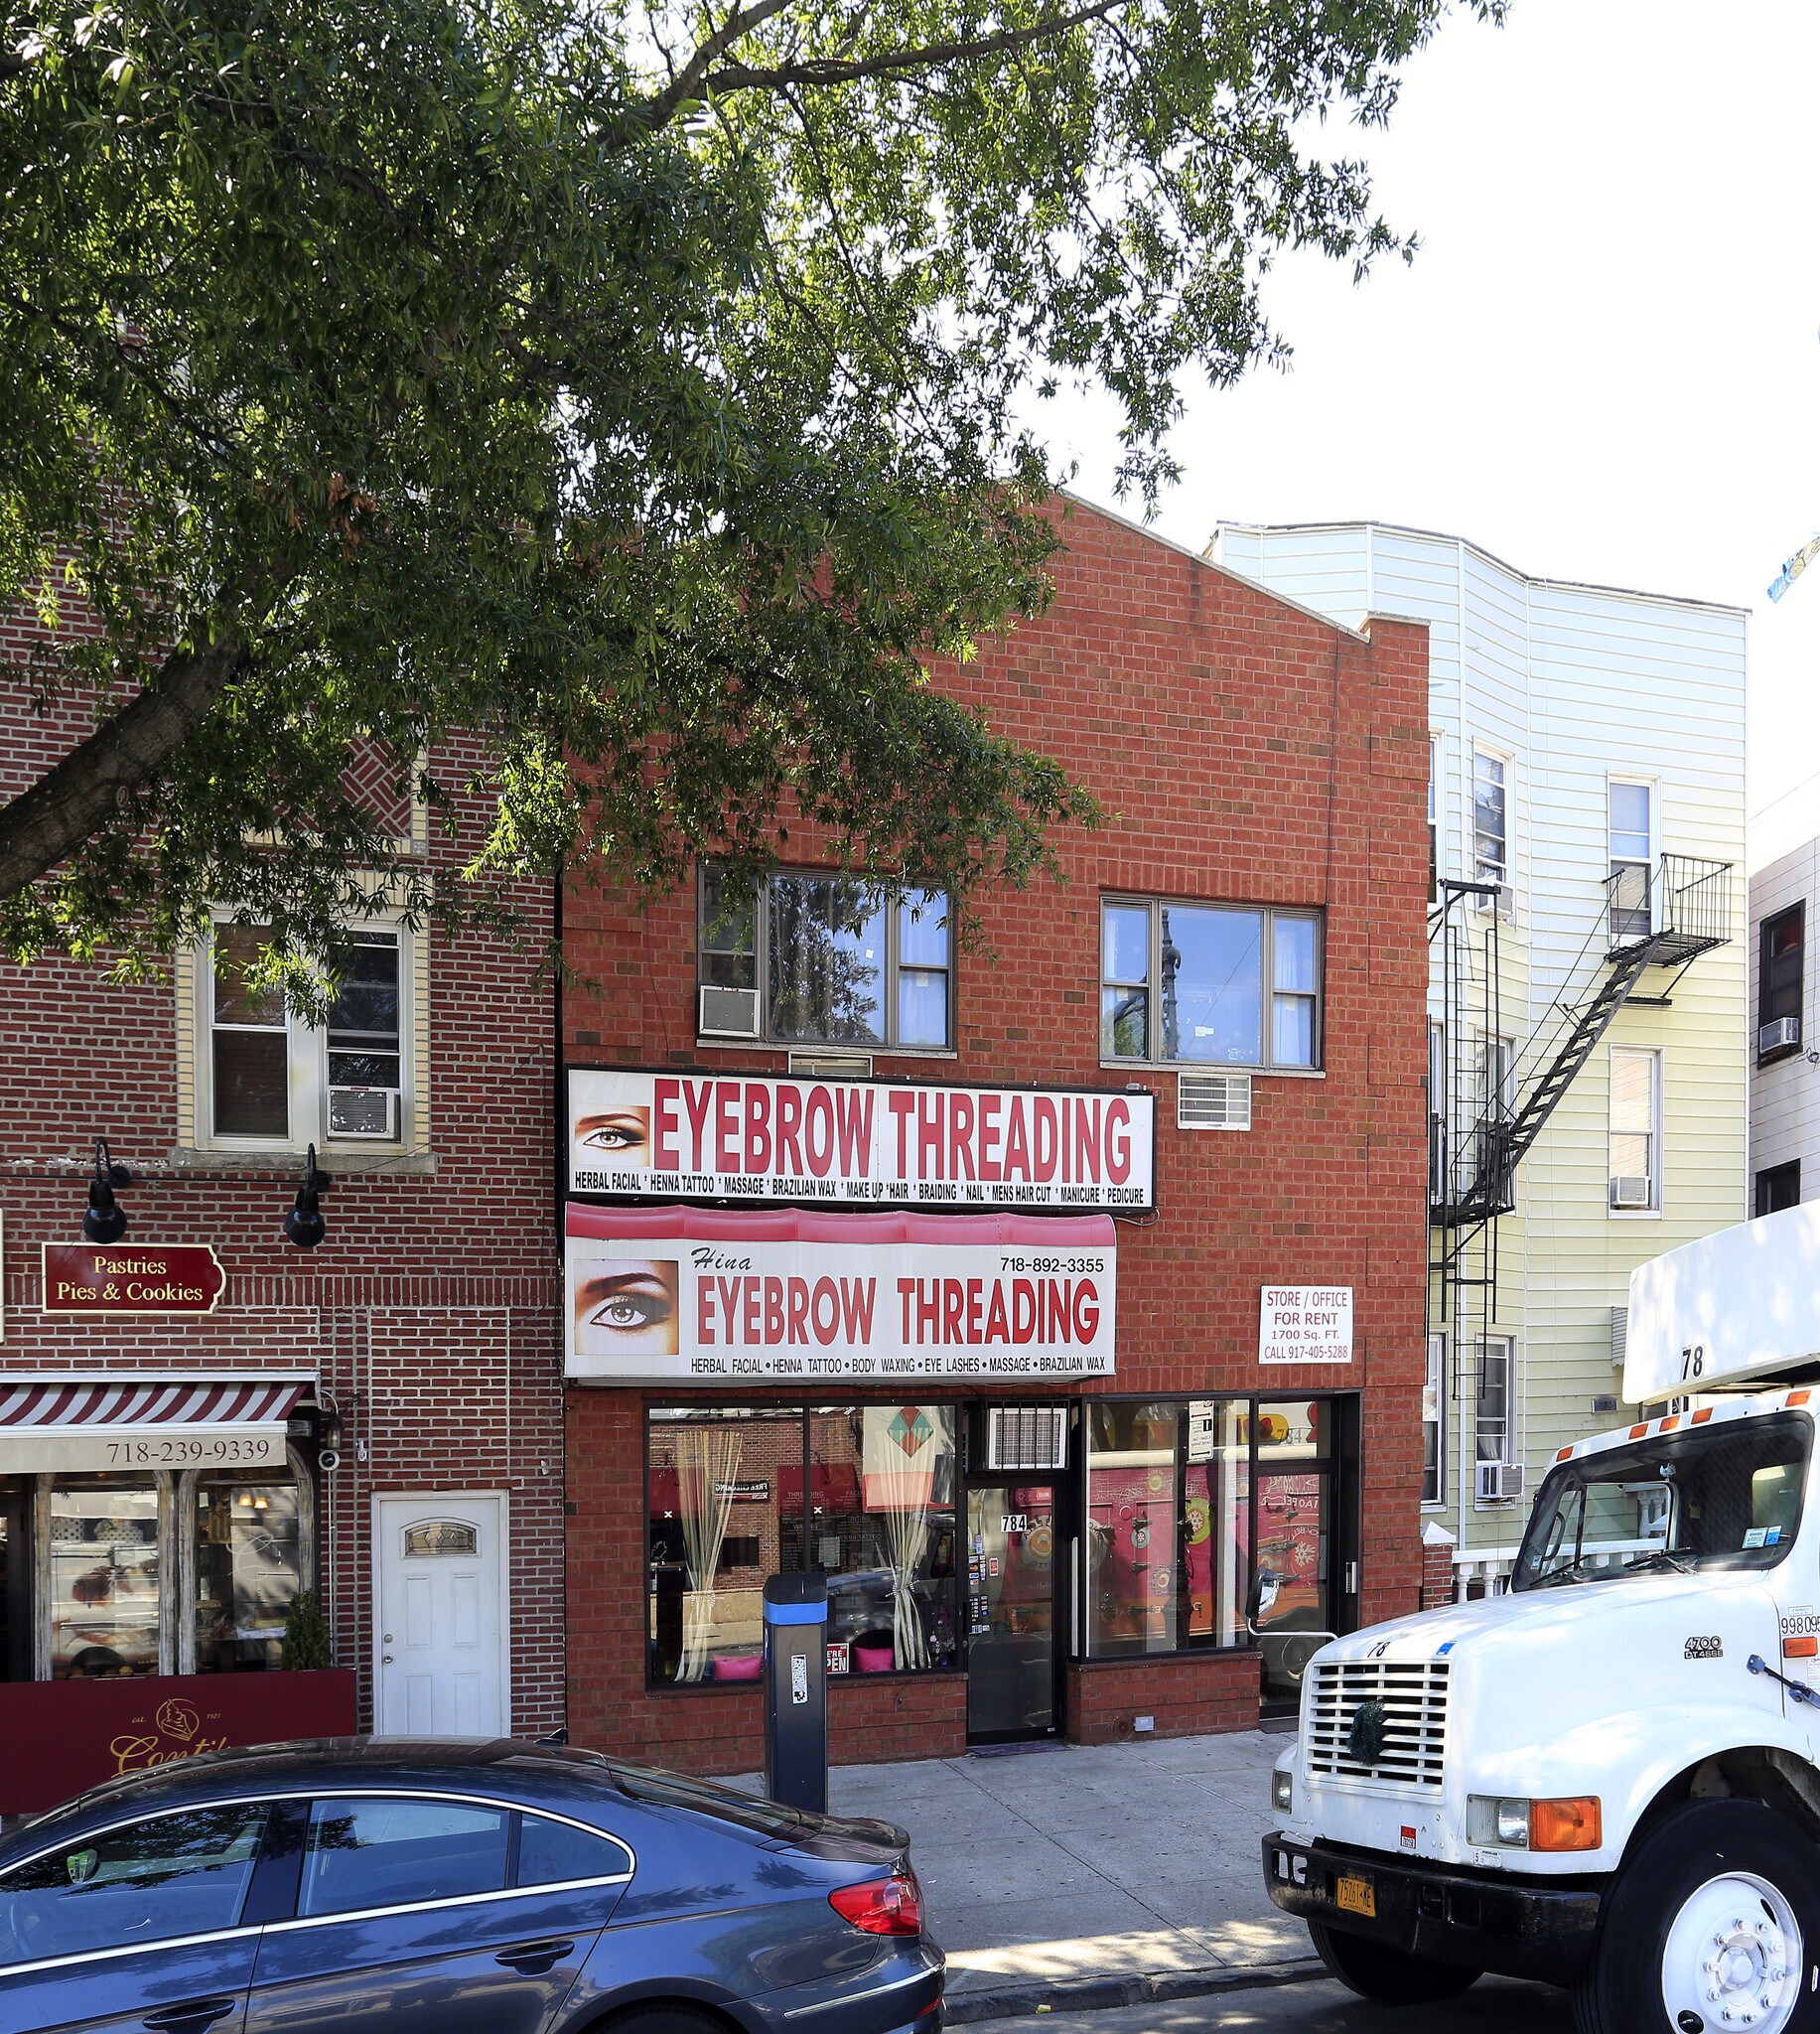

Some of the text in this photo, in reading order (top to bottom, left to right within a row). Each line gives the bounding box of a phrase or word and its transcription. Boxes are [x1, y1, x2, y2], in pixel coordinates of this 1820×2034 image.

[653, 1078, 1131, 1186] EYEBROW THREADING
[575, 1171, 641, 1191] HERBAL FACIAL
[650, 1174, 714, 1193] HENNA TATTOO
[724, 1177, 764, 1195] MASSAGE
[772, 1178, 837, 1197] BRAZILIAN WAX
[847, 1181, 884, 1199] MAKE UP
[891, 1183, 909, 1199] HAIR
[918, 1184, 956, 1200] BRAIDING
[966, 1185, 984, 1201] NAIL
[992, 1185, 1050, 1202] MENS HAIR CUT
[1060, 1187, 1099, 1203] MANICURE
[1107, 1188, 1144, 1204] PEDICURE
[93, 1255, 167, 1274] Pastries
[691, 1247, 752, 1270] Hina
[1001, 1257, 1104, 1272] 718-892-3355
[57, 1281, 204, 1301] Pies & Cookies
[1267, 1291, 1301, 1306] STORE
[1313, 1291, 1347, 1307] OFFICE
[698, 1275, 1099, 1346] EYEBROW THREADING
[1274, 1312, 1338, 1325] FOR RENT
[1271, 1330, 1339, 1341] 1700 Sq. FT.
[1264, 1346, 1347, 1359] CALL 917-405-5288
[691, 1359, 763, 1373] HERBAL FACIAL
[772, 1359, 841, 1373] HENNA TATTOO
[852, 1358, 914, 1373] BODY WAXING
[924, 1358, 980, 1372] EYE LASHES
[989, 1357, 1030, 1372] MASSAGE
[1040, 1357, 1105, 1371] BRAZILIAN WAX
[1682, 1346, 1704, 1380] 78
[106, 1439, 270, 1463] 718-239-9339
[1003, 1516, 1026, 1531] 784
[1367, 1642, 1391, 1658] 78
[1685, 1636, 1723, 1650] 4700
